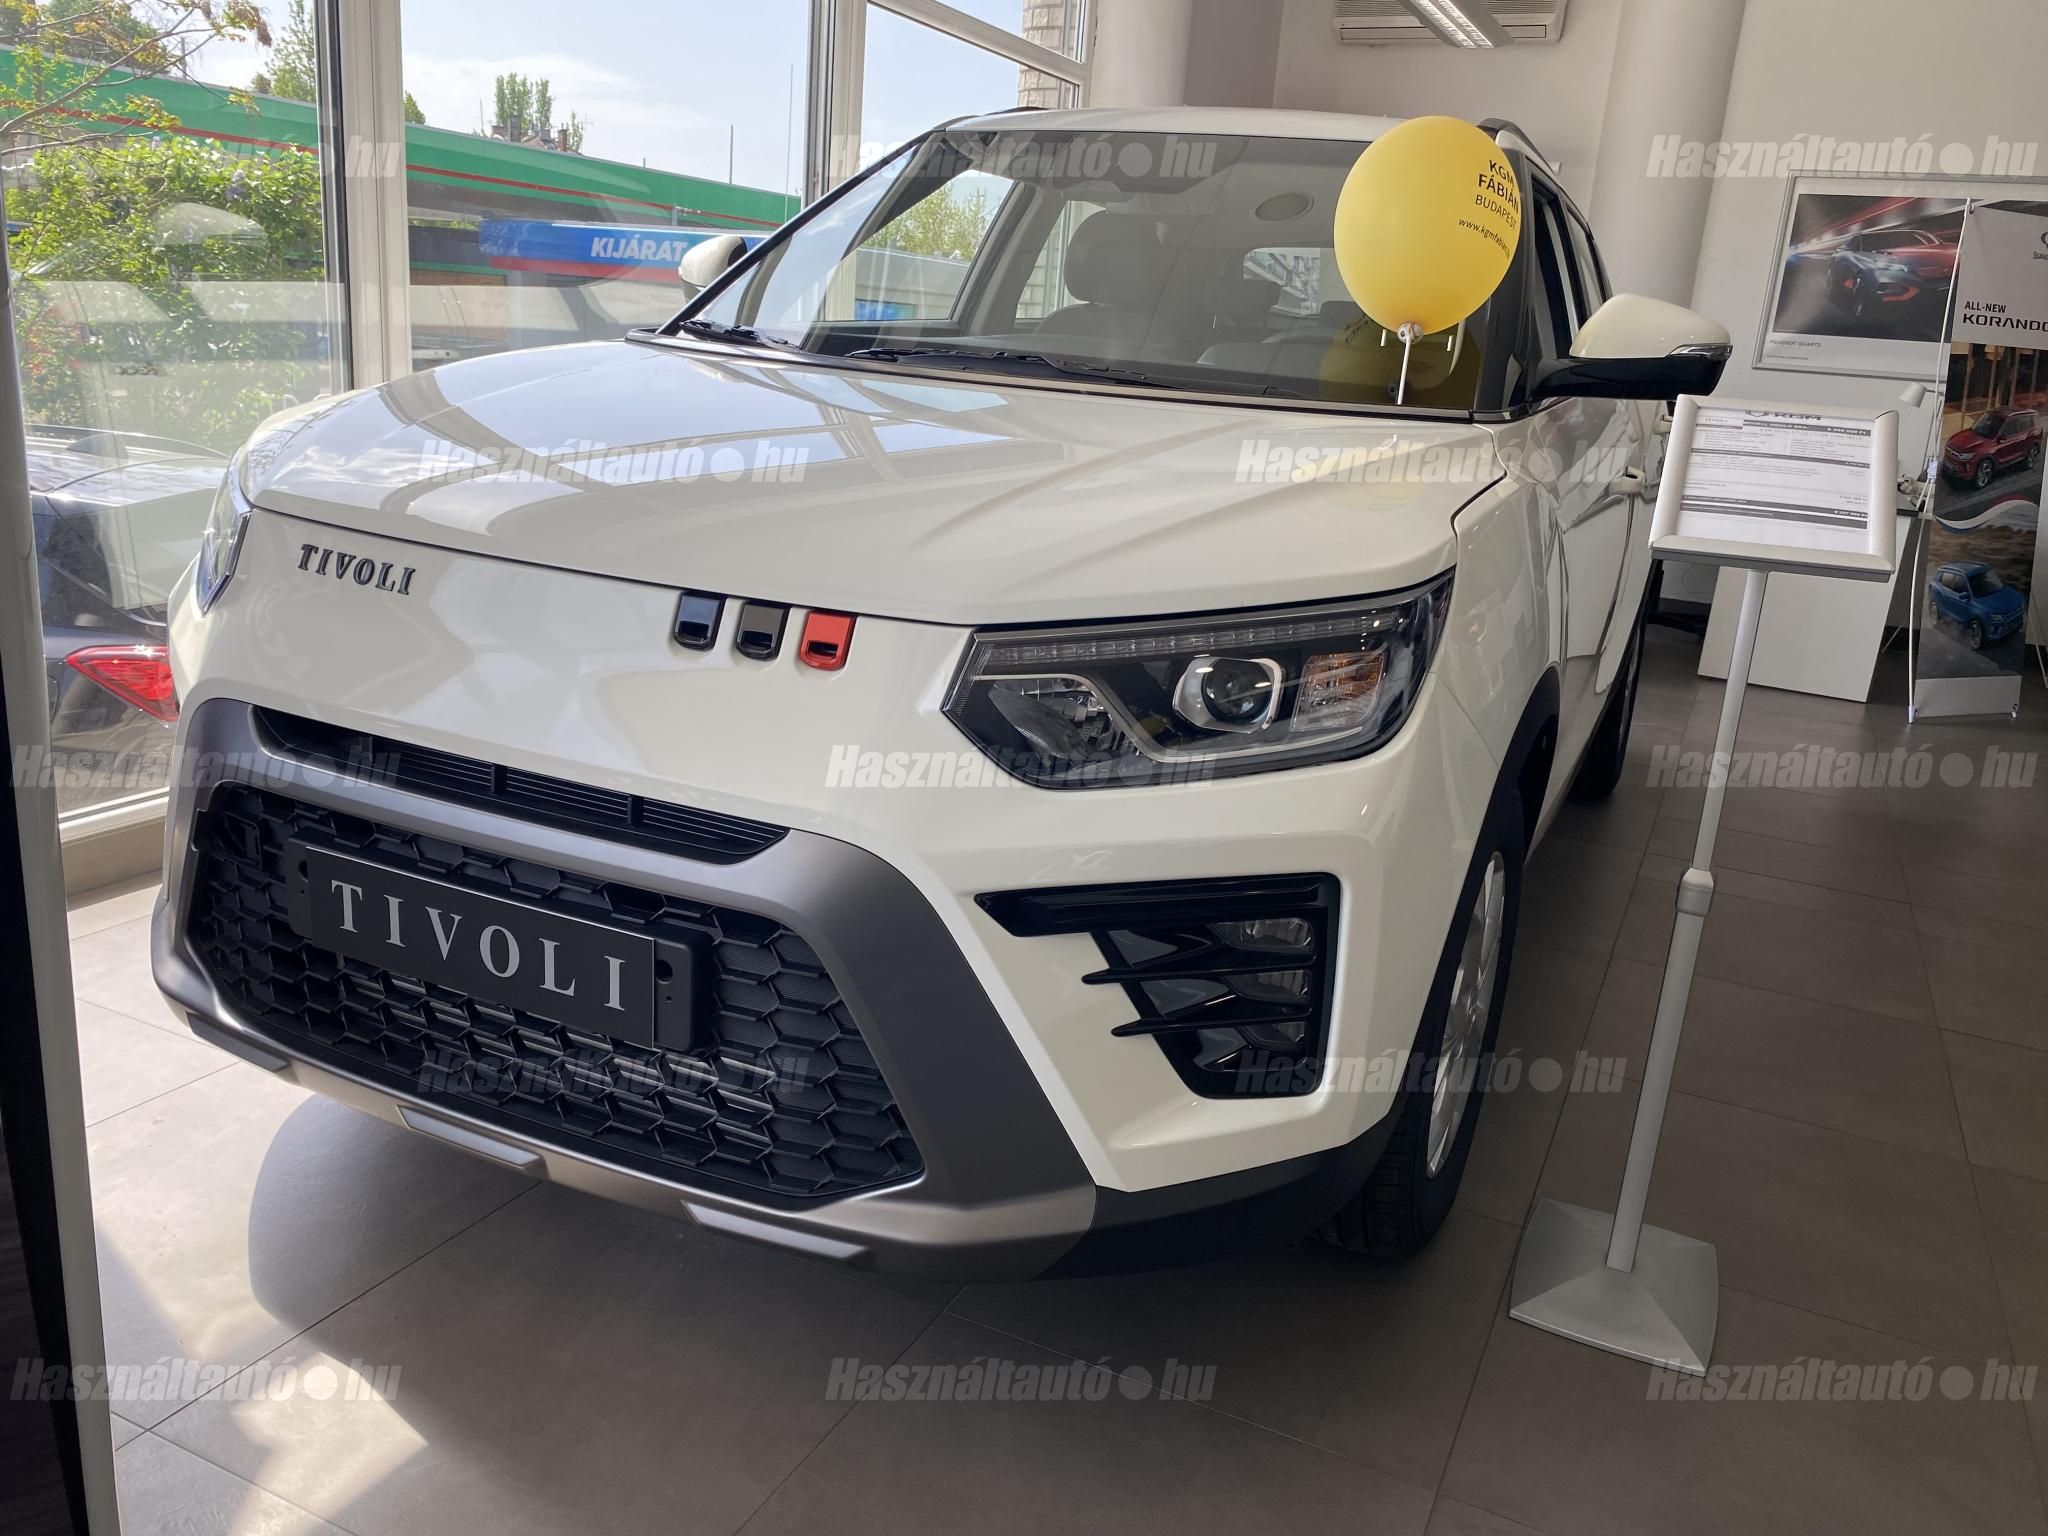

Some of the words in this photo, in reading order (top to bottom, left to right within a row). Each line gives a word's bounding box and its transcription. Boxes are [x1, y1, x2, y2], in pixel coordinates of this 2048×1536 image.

[1489, 160, 1515, 188] KGM
[1478, 173, 1519, 214] FÁBIÁN
[1475, 194, 1517, 230] BUDAPEST
[590, 233, 688, 261] KIJÁRAT
[1964, 301, 2007, 313] ALL-NEW
[297, 543, 416, 595] TIVOLI
[331, 879, 626, 1012] TIVOLI
